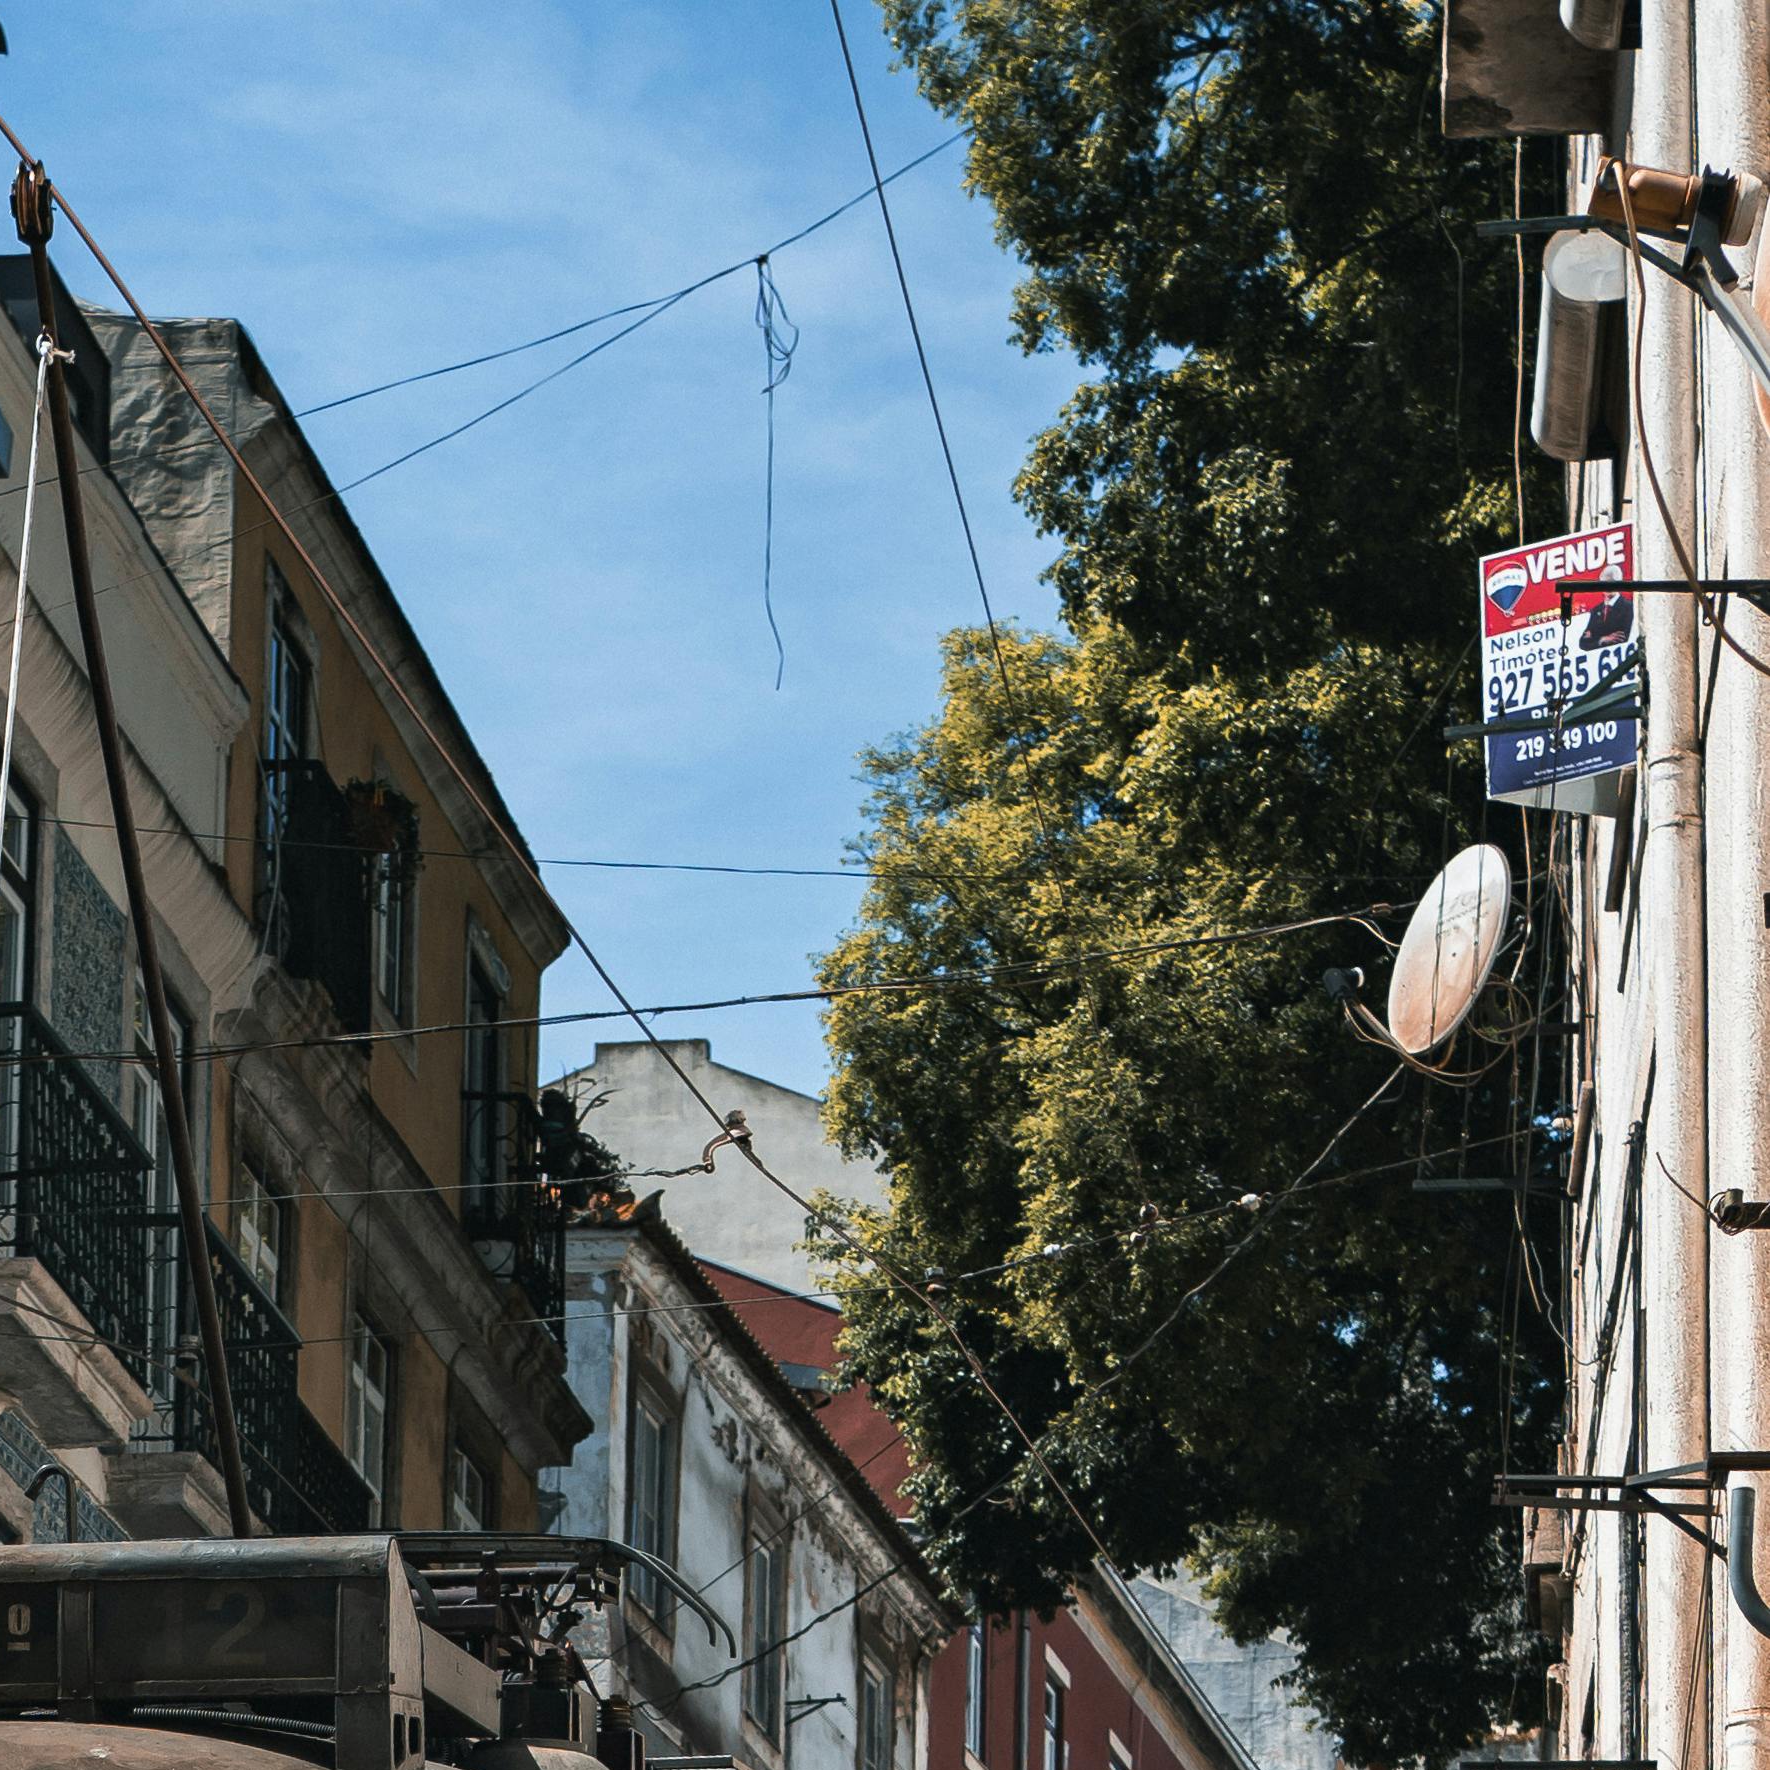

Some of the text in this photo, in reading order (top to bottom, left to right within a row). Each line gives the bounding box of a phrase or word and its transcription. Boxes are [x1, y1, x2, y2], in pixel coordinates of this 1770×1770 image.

[1526, 531, 1626, 584] VENDE
[1489, 646, 1568, 674] Timóteo
[1491, 626, 1556, 654] Nelson
[1489, 668, 1533, 713] 927
[1543, 655, 1590, 700] 565
[1516, 736, 1545, 761] 219
[1585, 720, 1618, 745] 100
